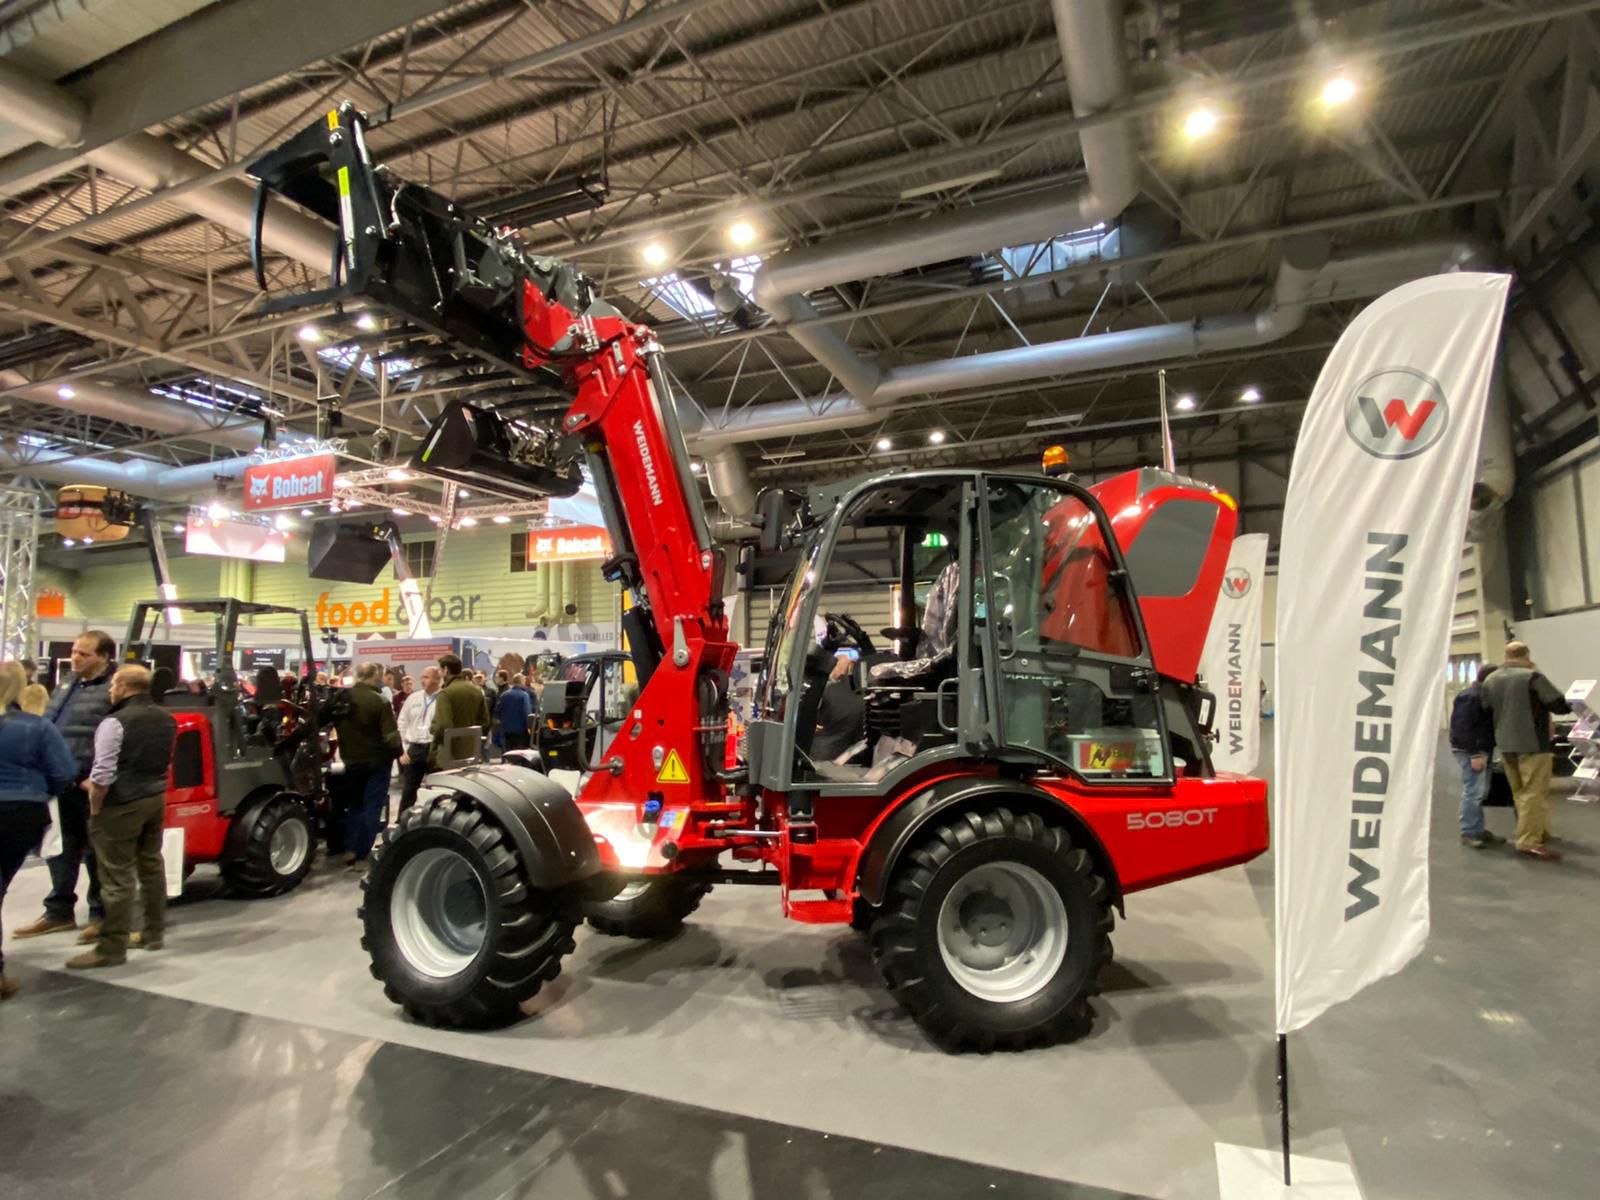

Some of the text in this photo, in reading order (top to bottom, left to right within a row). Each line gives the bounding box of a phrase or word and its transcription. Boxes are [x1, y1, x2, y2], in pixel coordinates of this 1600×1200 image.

[272, 470, 323, 499] Bobcat
[633, 419, 663, 506] WEIDEMANN
[315, 587, 390, 629] food
[425, 585, 481, 623] bar
[1227, 623, 1244, 756] WEIDEMANN
[1344, 531, 1409, 922] WEIDEMANN
[1127, 808, 1218, 830] 5080T
